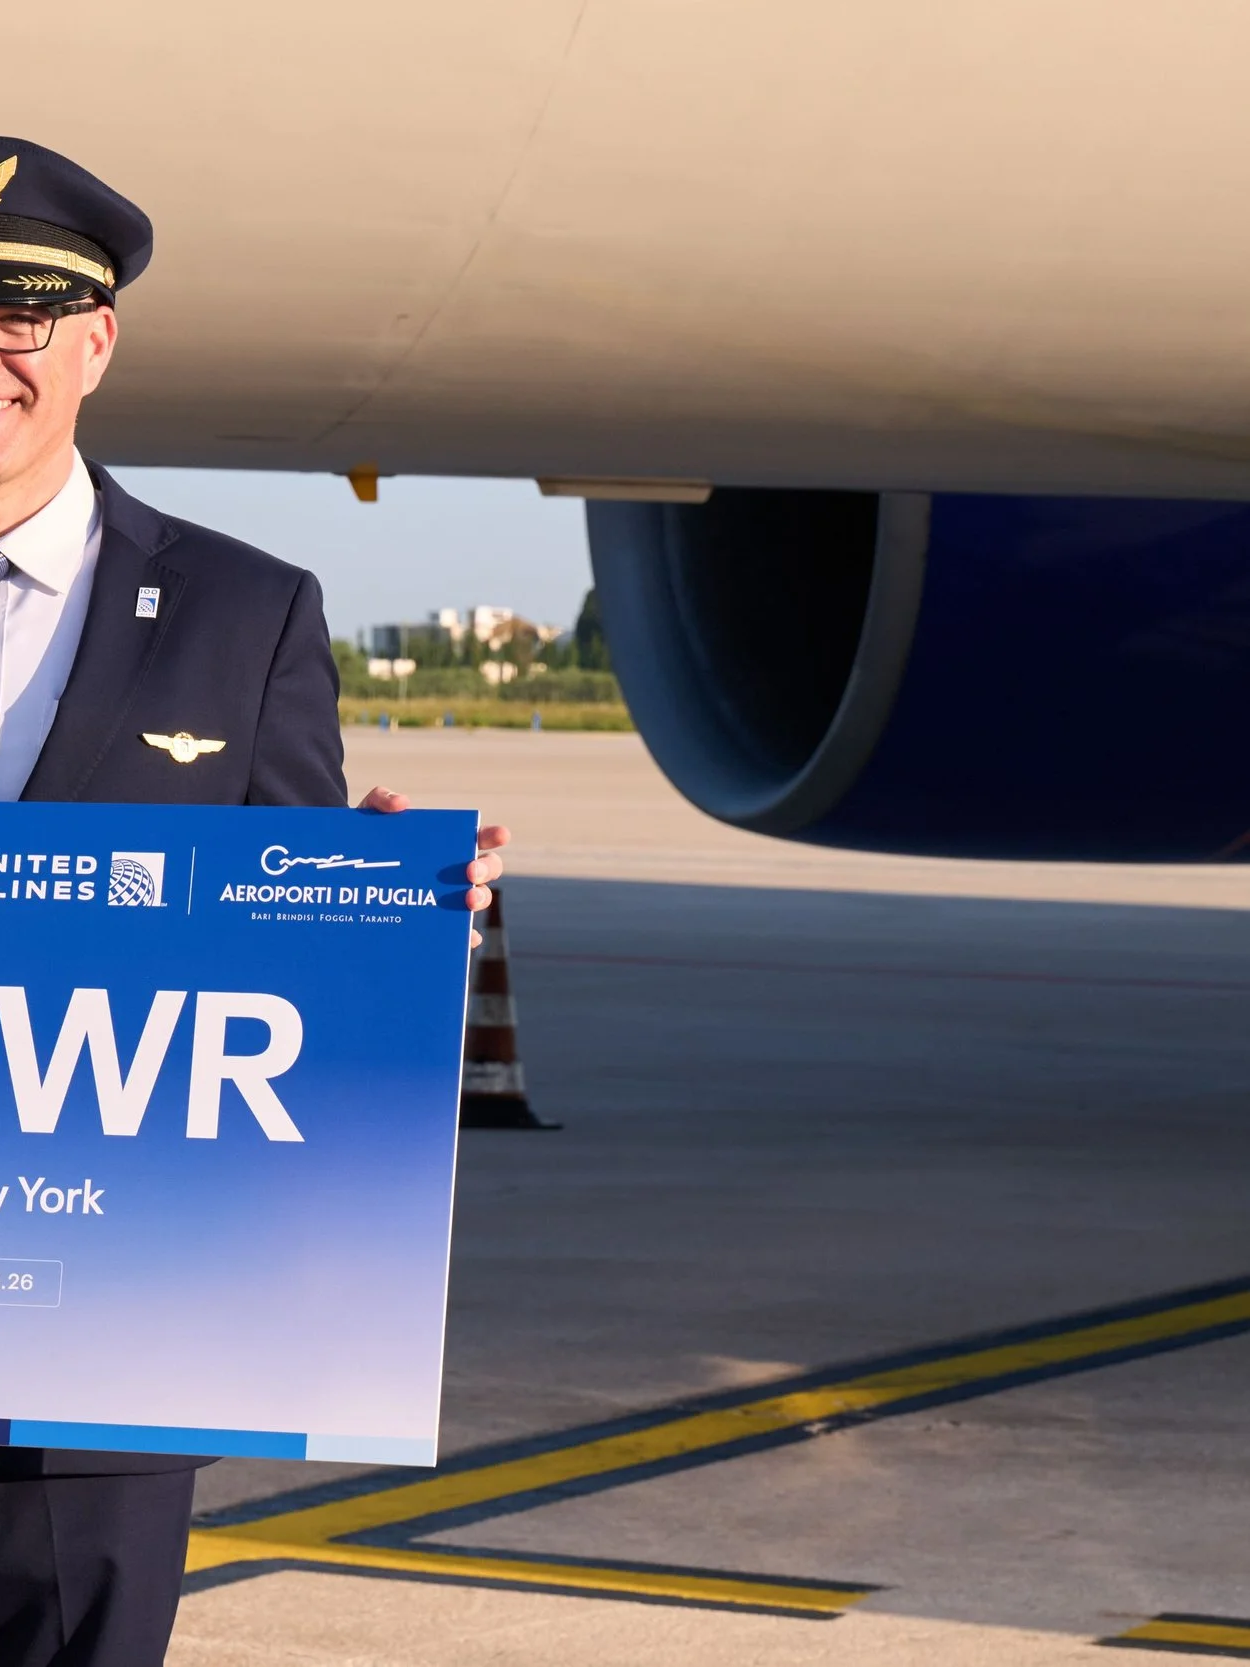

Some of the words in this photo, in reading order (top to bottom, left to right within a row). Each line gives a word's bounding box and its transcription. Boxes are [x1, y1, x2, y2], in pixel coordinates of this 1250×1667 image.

[219, 883, 332, 904] AEROPORTI
[338, 887, 359, 905] DI
[365, 886, 437, 907] PUGLIA
[251, 912, 271, 920] BARI
[276, 913, 314, 921] BRINDISI
[319, 914, 354, 922] FOGGIA
[359, 915, 402, 923] TARANTO
[17, 1176, 104, 1215] York
